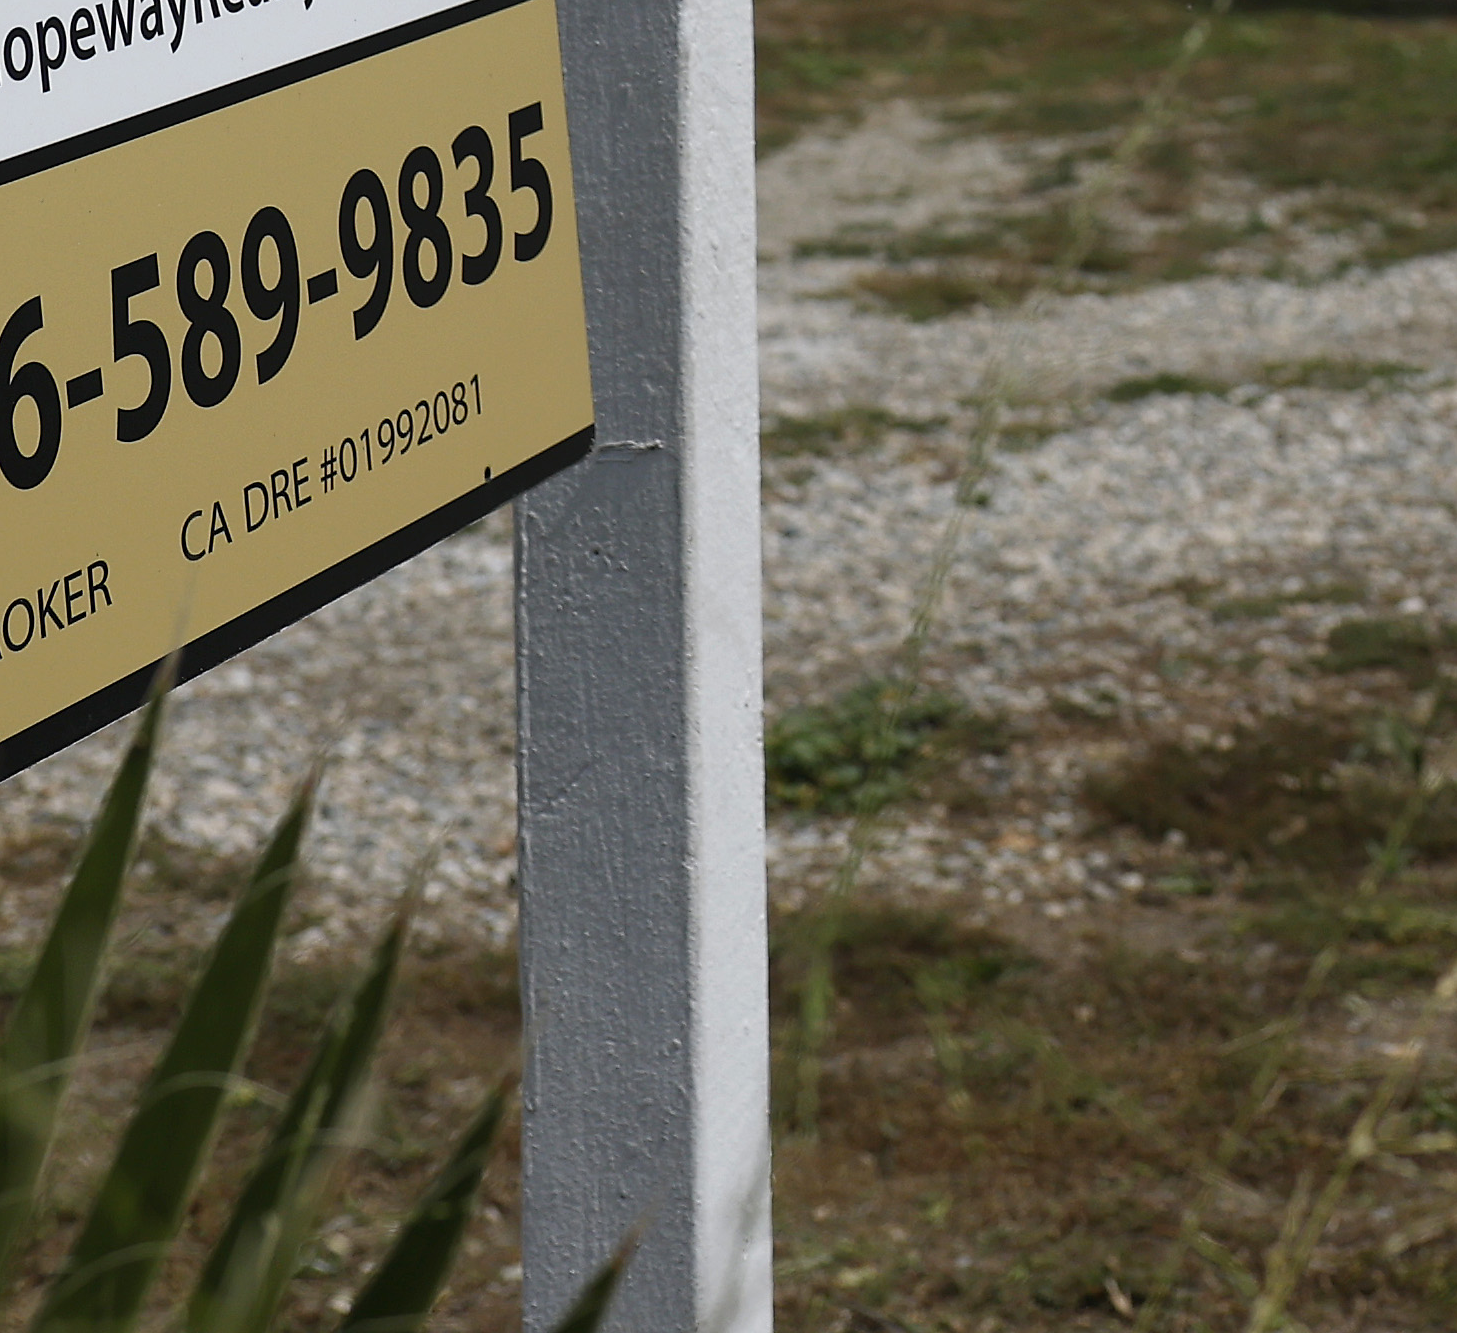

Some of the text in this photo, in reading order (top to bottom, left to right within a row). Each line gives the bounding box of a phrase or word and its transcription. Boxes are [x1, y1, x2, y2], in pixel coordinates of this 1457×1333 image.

[180, 509, 233, 563] CA
[244, 455, 312, 534] DRE
[320, 373, 484, 493] #01992081
